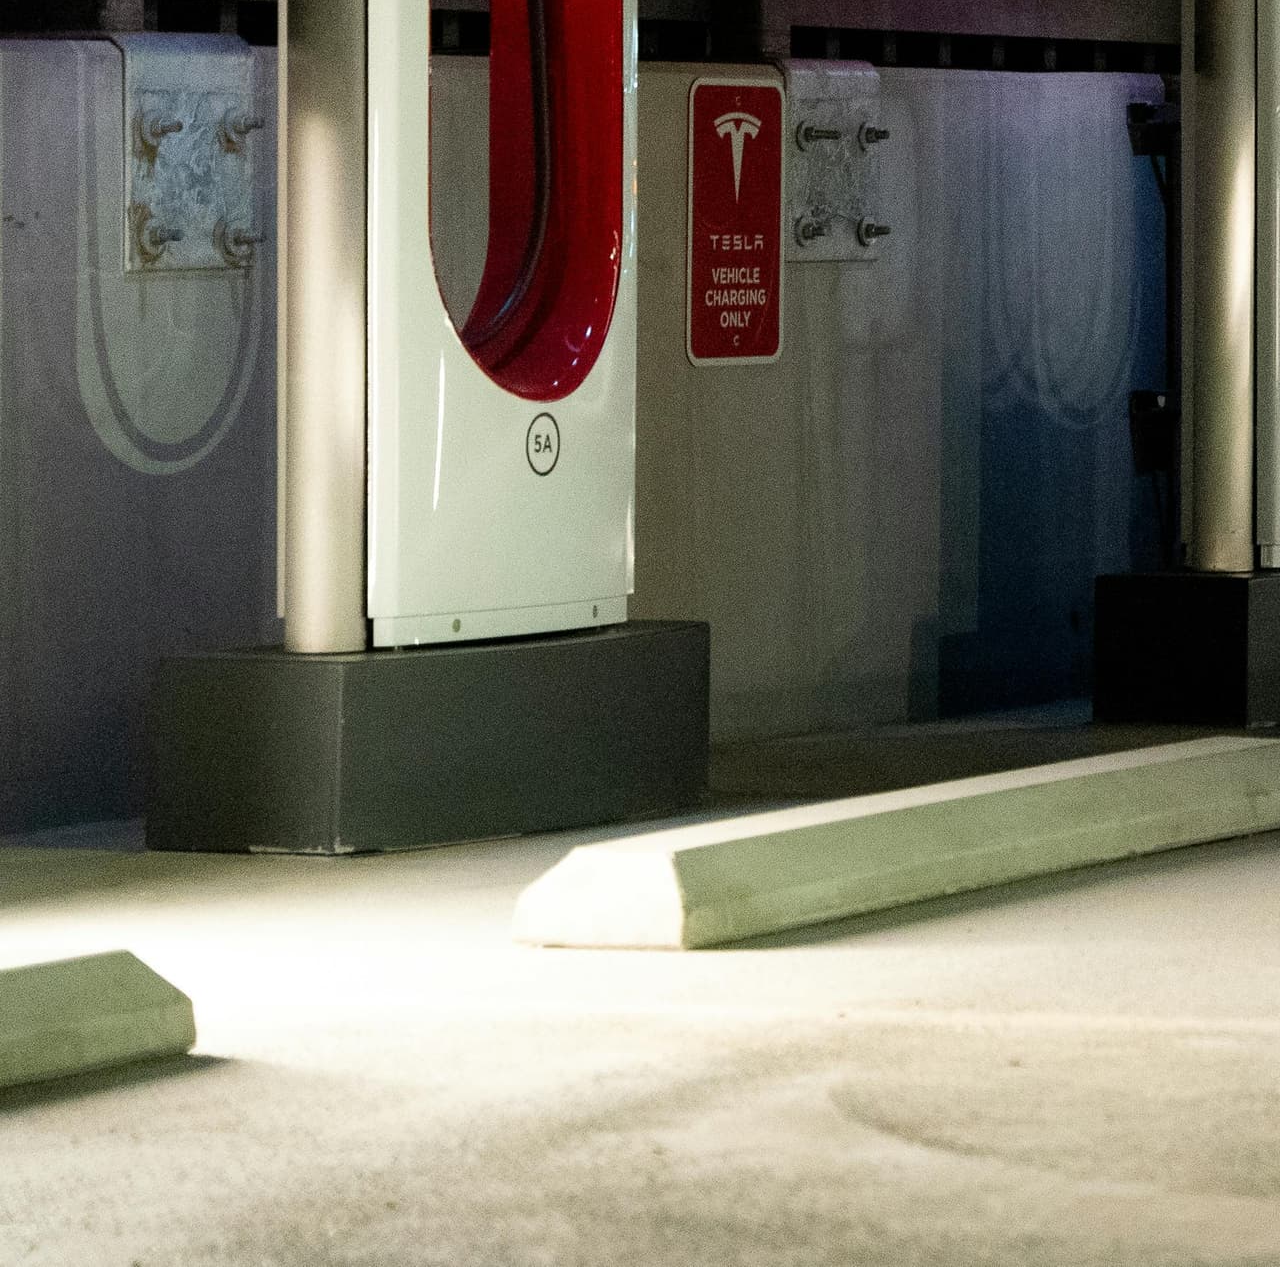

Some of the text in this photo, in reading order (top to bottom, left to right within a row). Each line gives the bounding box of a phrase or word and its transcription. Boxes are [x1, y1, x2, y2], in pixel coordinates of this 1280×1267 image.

[709, 234, 764, 251] TESLA
[711, 267, 761, 285] VEHICLE
[705, 289, 767, 307] CHARGING
[720, 311, 751, 328] ONLY
[534, 433, 553, 453] 5A
